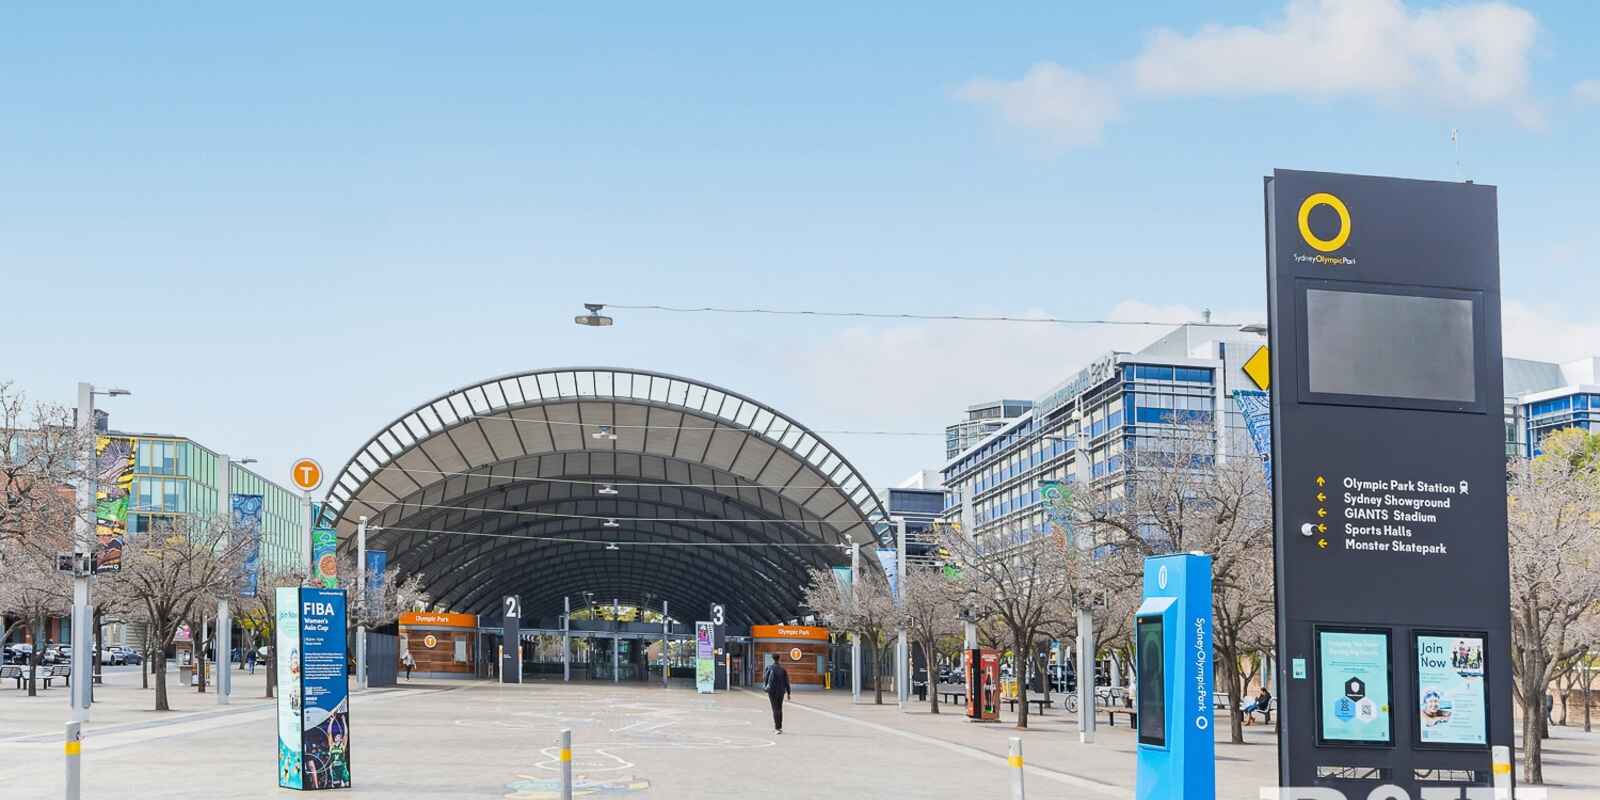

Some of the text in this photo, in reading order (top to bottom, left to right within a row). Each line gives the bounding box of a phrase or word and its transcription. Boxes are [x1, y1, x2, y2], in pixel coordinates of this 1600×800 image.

[1343, 477, 1456, 493] Olympic Park Station
[1343, 493, 1451, 510] Sydney Showground
[1344, 508, 1437, 523] GIANTS Stadium
[1345, 523, 1412, 537] Sports Halls
[1345, 539, 1448, 556] Monster Skatepark
[303, 602, 335, 616] FIBA
[505, 597, 516, 618] 2
[713, 605, 724, 626] 3
[1420, 642, 1443, 656] Join
[1192, 617, 1208, 713] SydneyOlympicPark
[1421, 657, 1447, 668] Now
